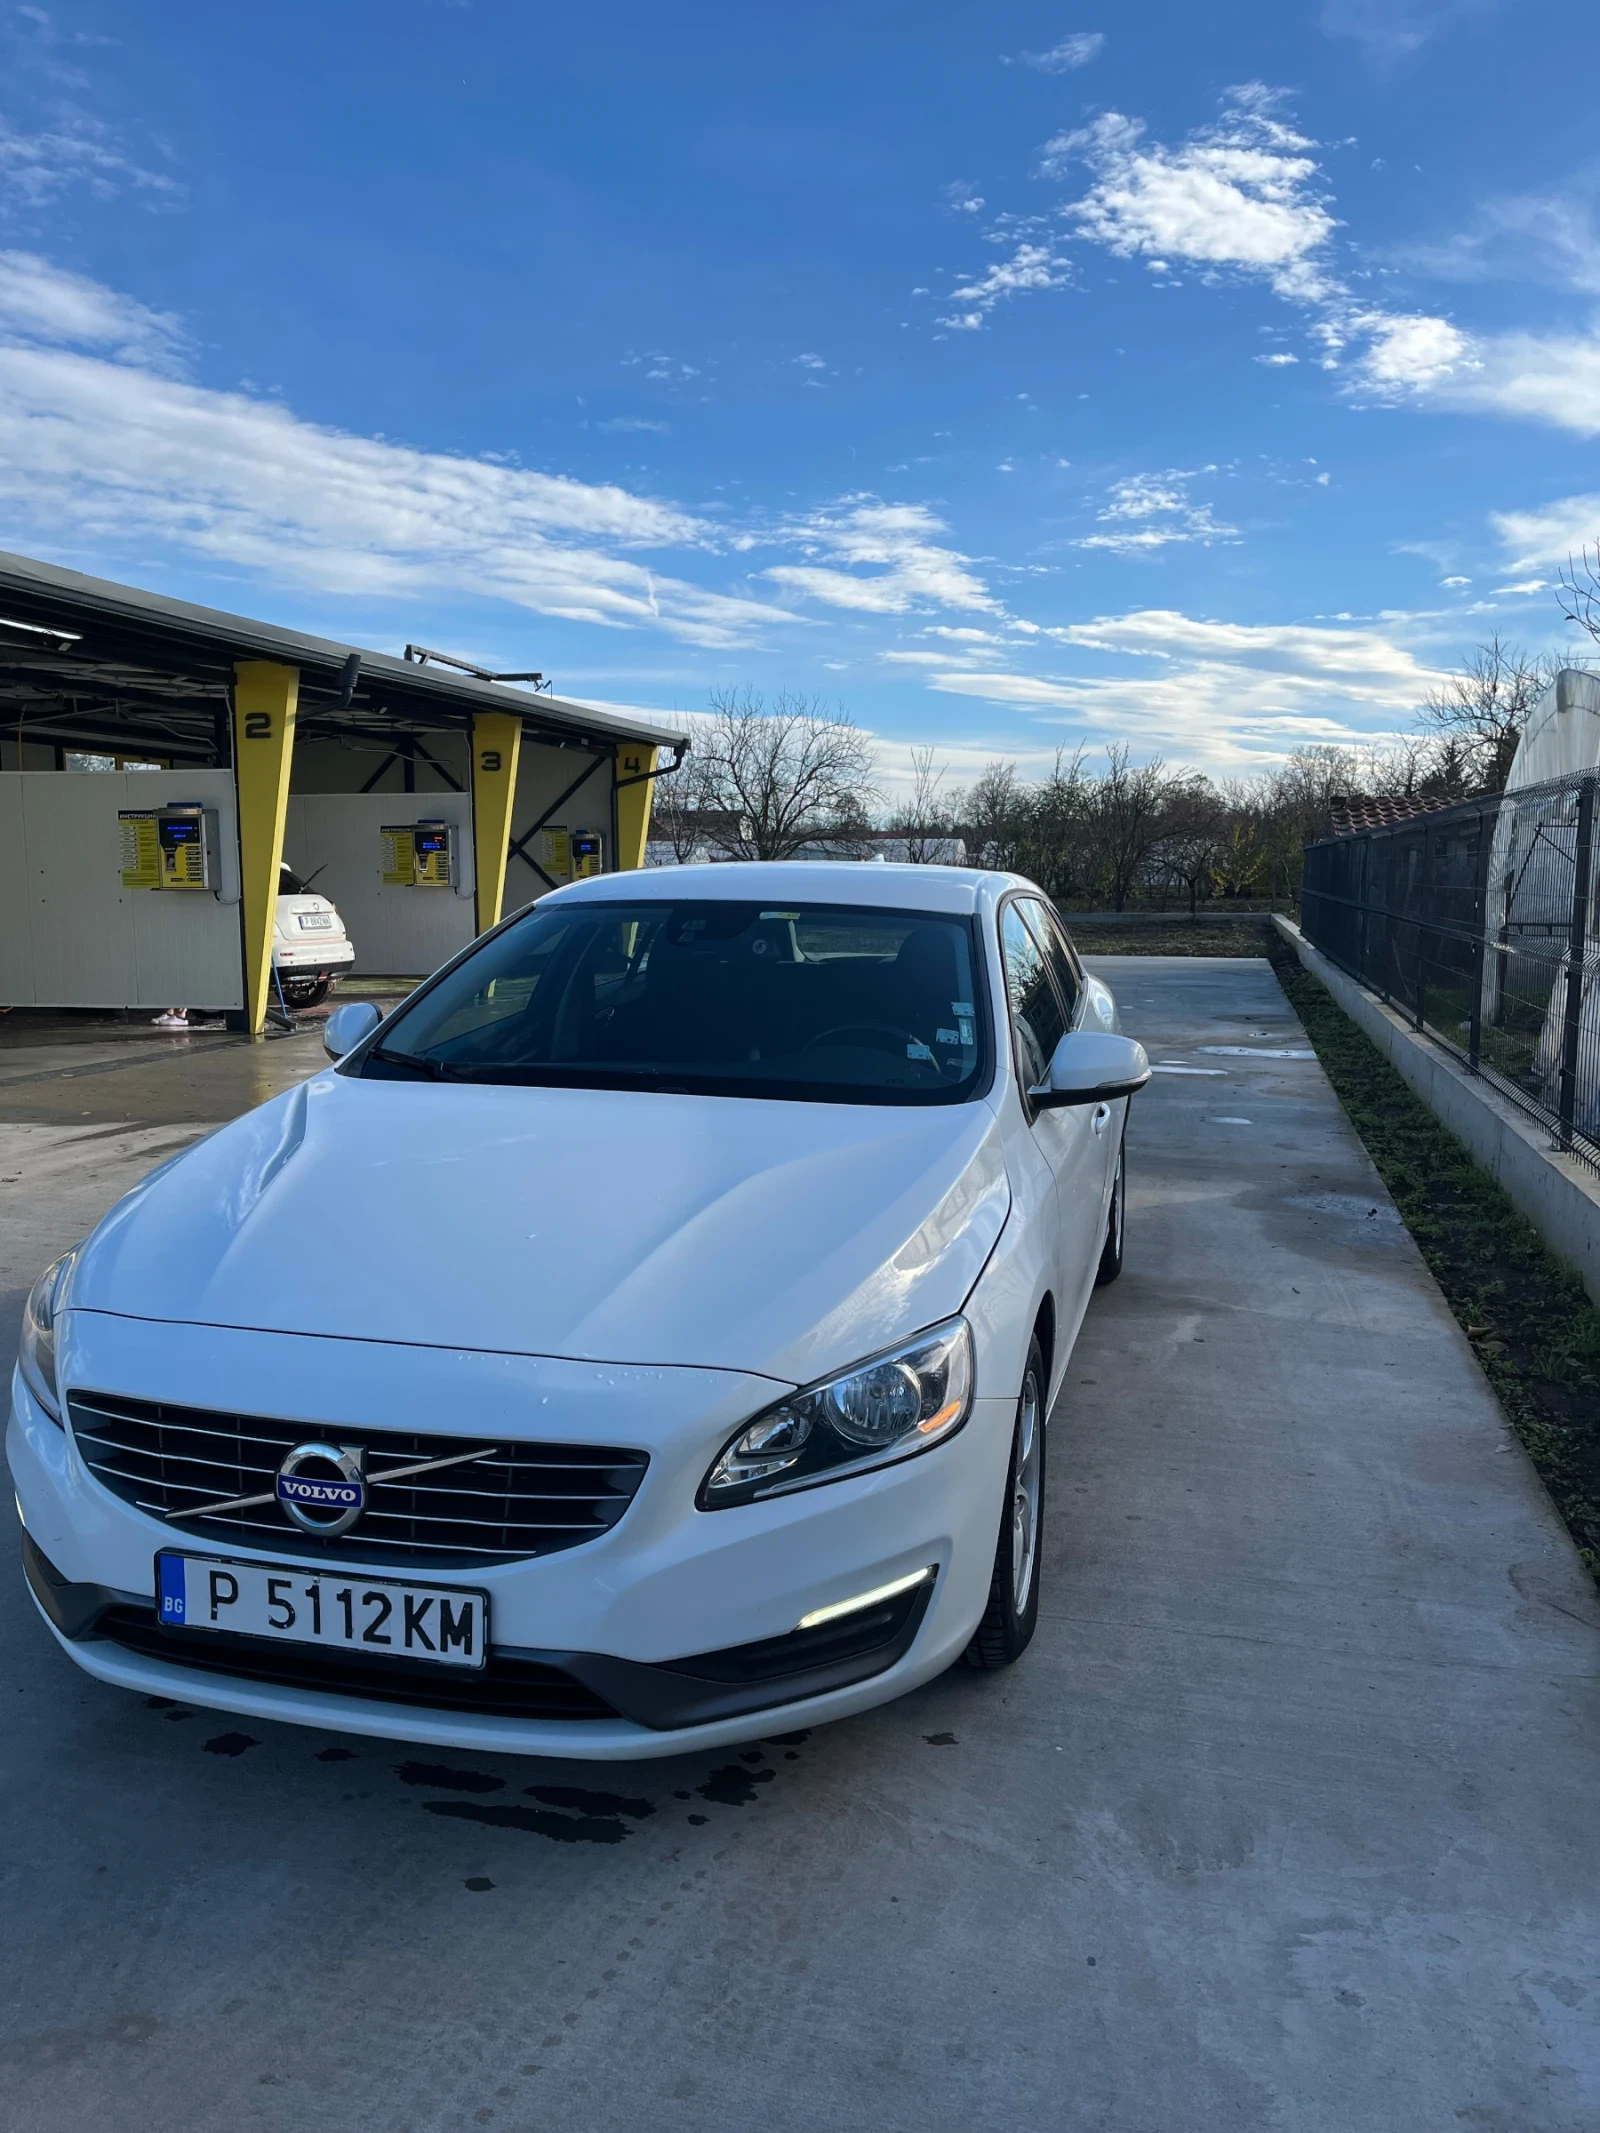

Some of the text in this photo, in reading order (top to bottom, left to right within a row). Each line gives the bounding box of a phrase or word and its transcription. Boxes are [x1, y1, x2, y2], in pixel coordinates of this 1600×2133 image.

[245, 712, 272, 739] 2
[481, 751, 501, 771] 3
[624, 757, 641, 773] 4
[281, 1481, 357, 1502] VOLVO
[164, 1596, 183, 1614] BG
[209, 1570, 239, 1621] P
